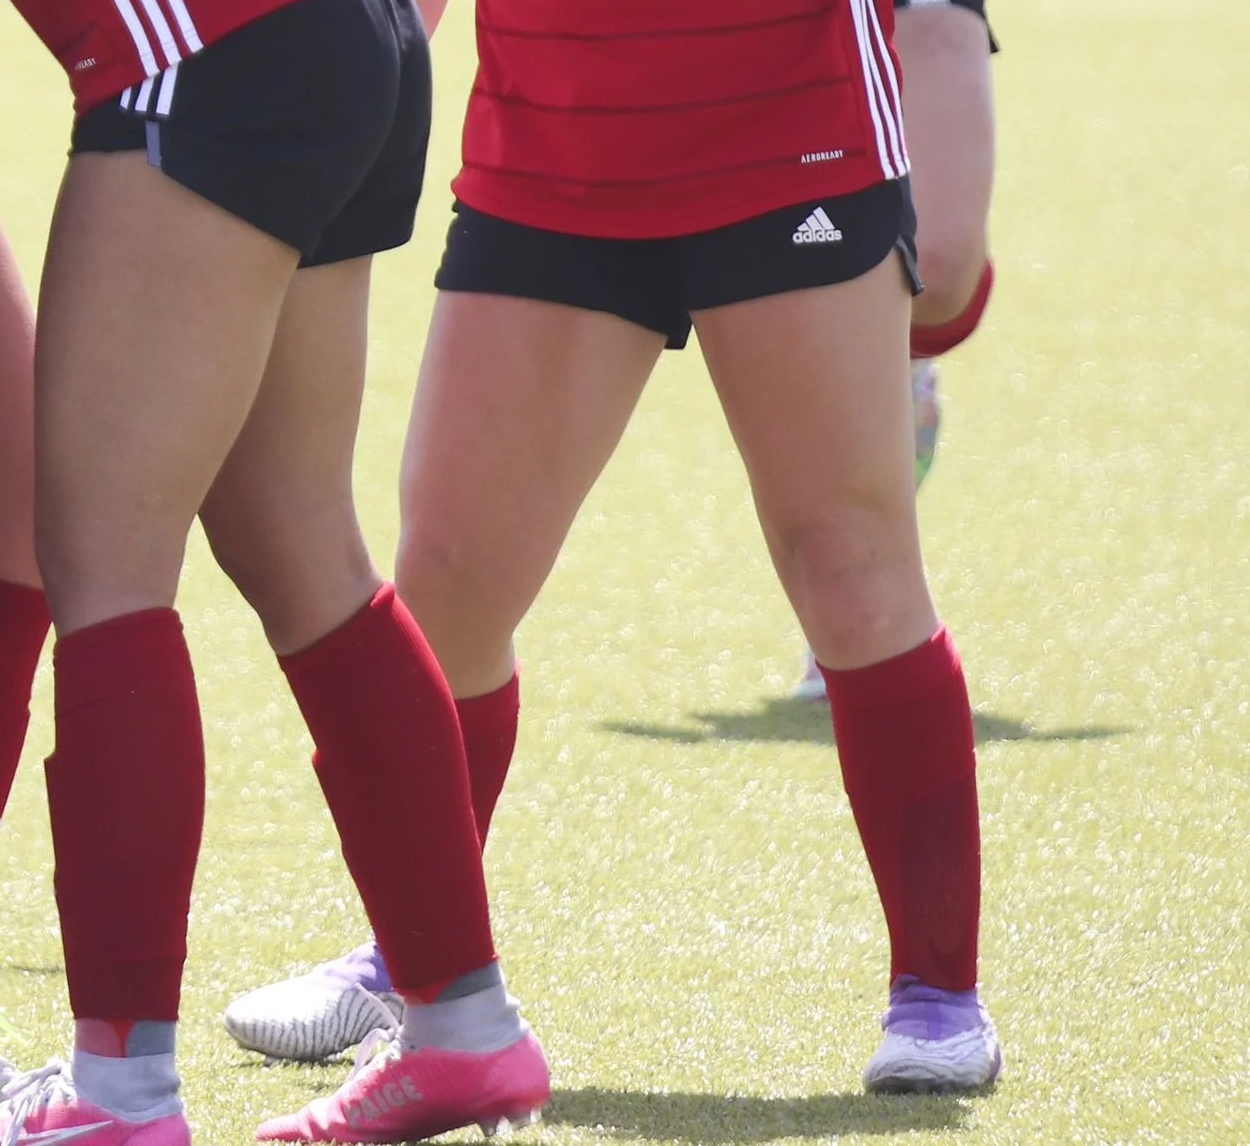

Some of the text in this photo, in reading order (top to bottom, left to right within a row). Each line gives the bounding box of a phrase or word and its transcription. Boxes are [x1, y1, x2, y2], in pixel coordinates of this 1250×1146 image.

[800, 149, 844, 164] AEROREADY
[792, 228, 843, 244] adidas
[344, 1074, 423, 1129] PAIGE
